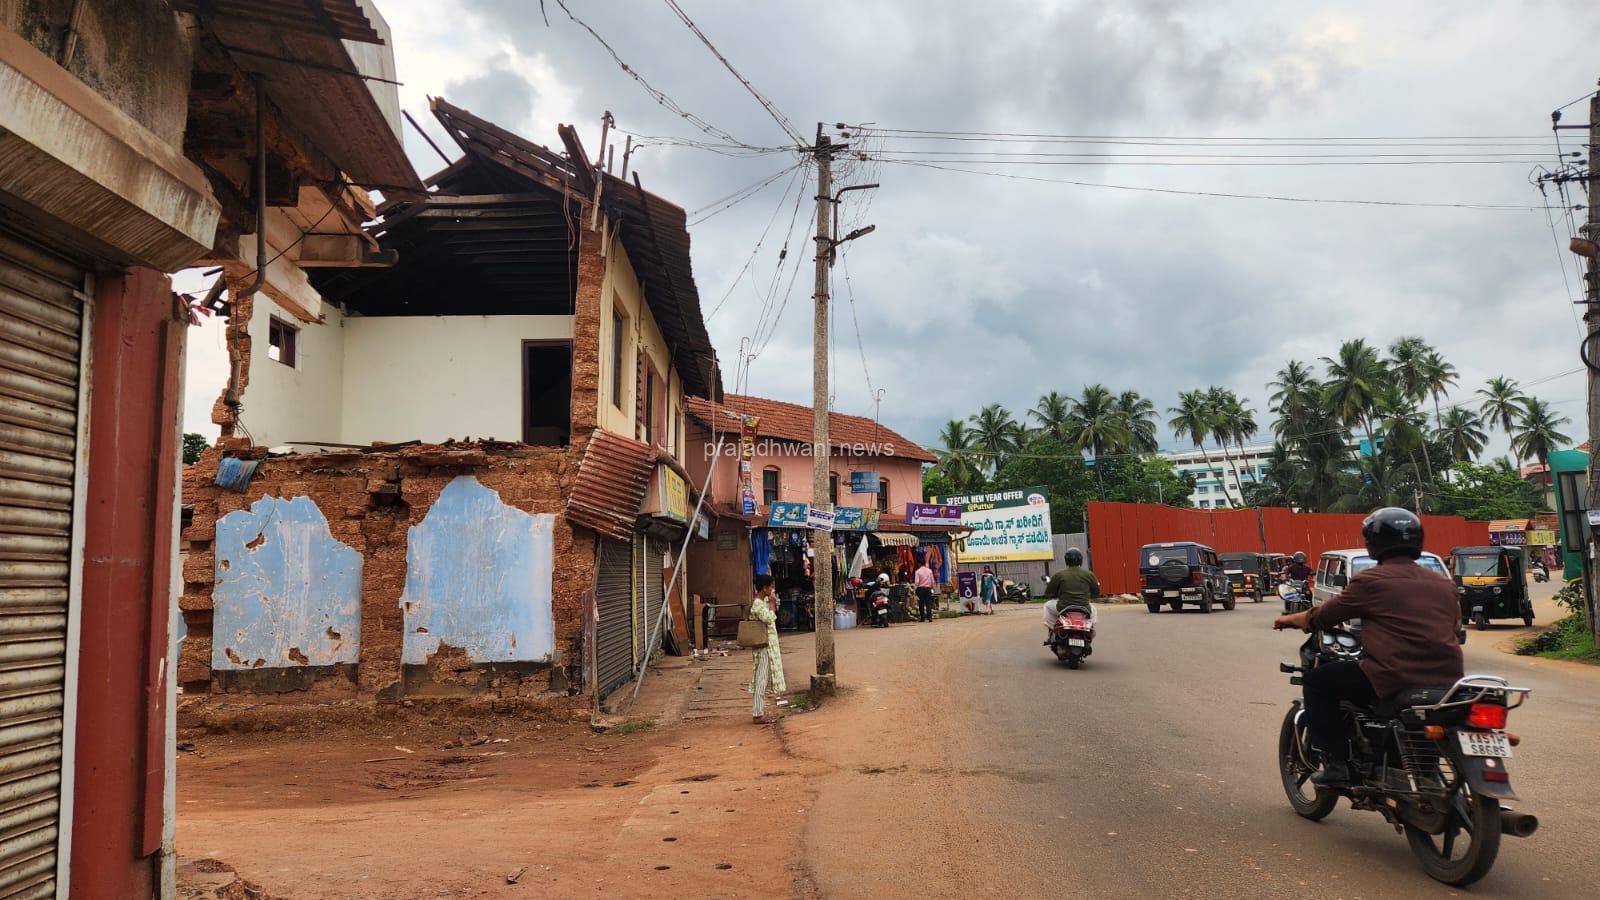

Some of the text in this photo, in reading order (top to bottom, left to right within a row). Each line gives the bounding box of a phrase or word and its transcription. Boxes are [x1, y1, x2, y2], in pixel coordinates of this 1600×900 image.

[946, 495, 970, 505] SPECIAL
[971, 494, 985, 503] NEW
[985, 492, 1002, 502] YEAR
[1003, 490, 1023, 500] OFFER
